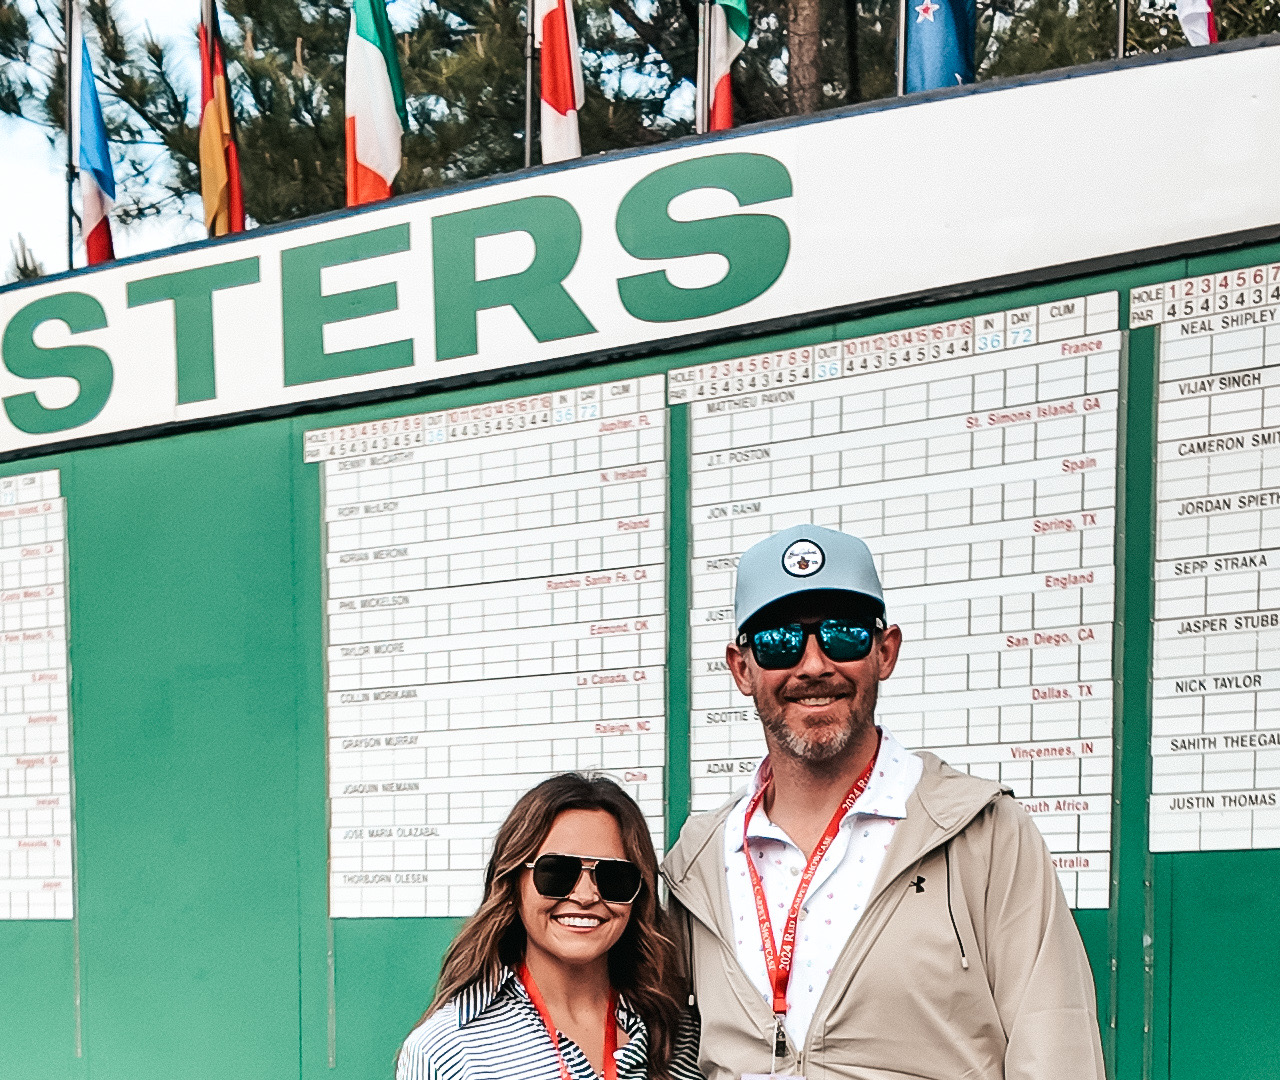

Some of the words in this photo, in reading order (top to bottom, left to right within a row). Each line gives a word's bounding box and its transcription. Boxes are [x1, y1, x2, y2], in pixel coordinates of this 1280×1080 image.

[1181, 320, 1214, 335] NEAL
[1221, 308, 1276, 329] SHIPLEY
[1061, 340, 1105, 355] France
[1179, 379, 1215, 395] VIJAY
[1219, 373, 1261, 390] SINGH
[988, 411, 1031, 426] Simons
[1083, 397, 1100, 411] GA
[1178, 436, 1244, 456] CAMERON
[729, 448, 770, 463] POSTON
[1062, 458, 1096, 474] Spain
[707, 506, 728, 519] JON
[1178, 498, 1231, 516] JORDAN
[1081, 514, 1096, 526] TX
[1175, 560, 1208, 576] SEPP
[1214, 555, 1267, 571] STRAKA
[1045, 571, 1094, 589] England
[1178, 618, 1227, 634] JASPER
[1007, 635, 1028, 648] San
[1078, 628, 1094, 641] CA
[1078, 685, 1092, 696] TX
[1176, 680, 1206, 692] NICK
[1213, 674, 1261, 689] TAYLOR
[707, 710, 748, 724] SCOTTIE
[1082, 742, 1093, 753] IN
[1171, 737, 1216, 752] SAHITH
[707, 763, 734, 774] ADAM
[1055, 800, 1089, 811] Africa
[1170, 796, 1214, 810] JUSTIN
[1221, 793, 1276, 807] THOMAS
[779, 944, 792, 971] 2024
